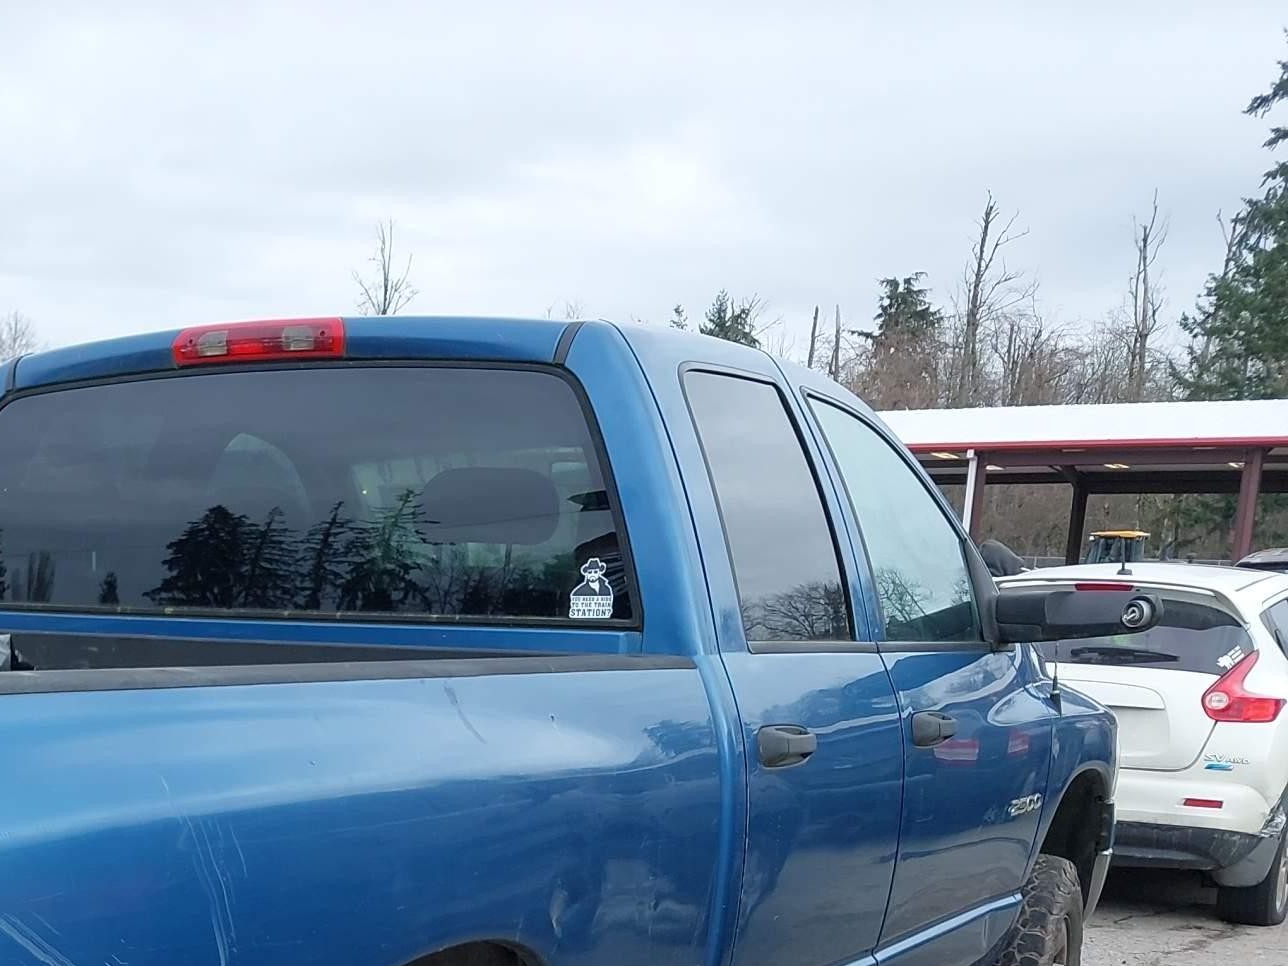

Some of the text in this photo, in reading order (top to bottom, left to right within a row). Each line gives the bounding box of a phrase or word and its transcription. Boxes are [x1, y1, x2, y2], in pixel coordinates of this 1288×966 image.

[570, 608, 611, 617] STATION?
[1203, 752, 1225, 763] SV
[1007, 793, 1042, 816] 2500
